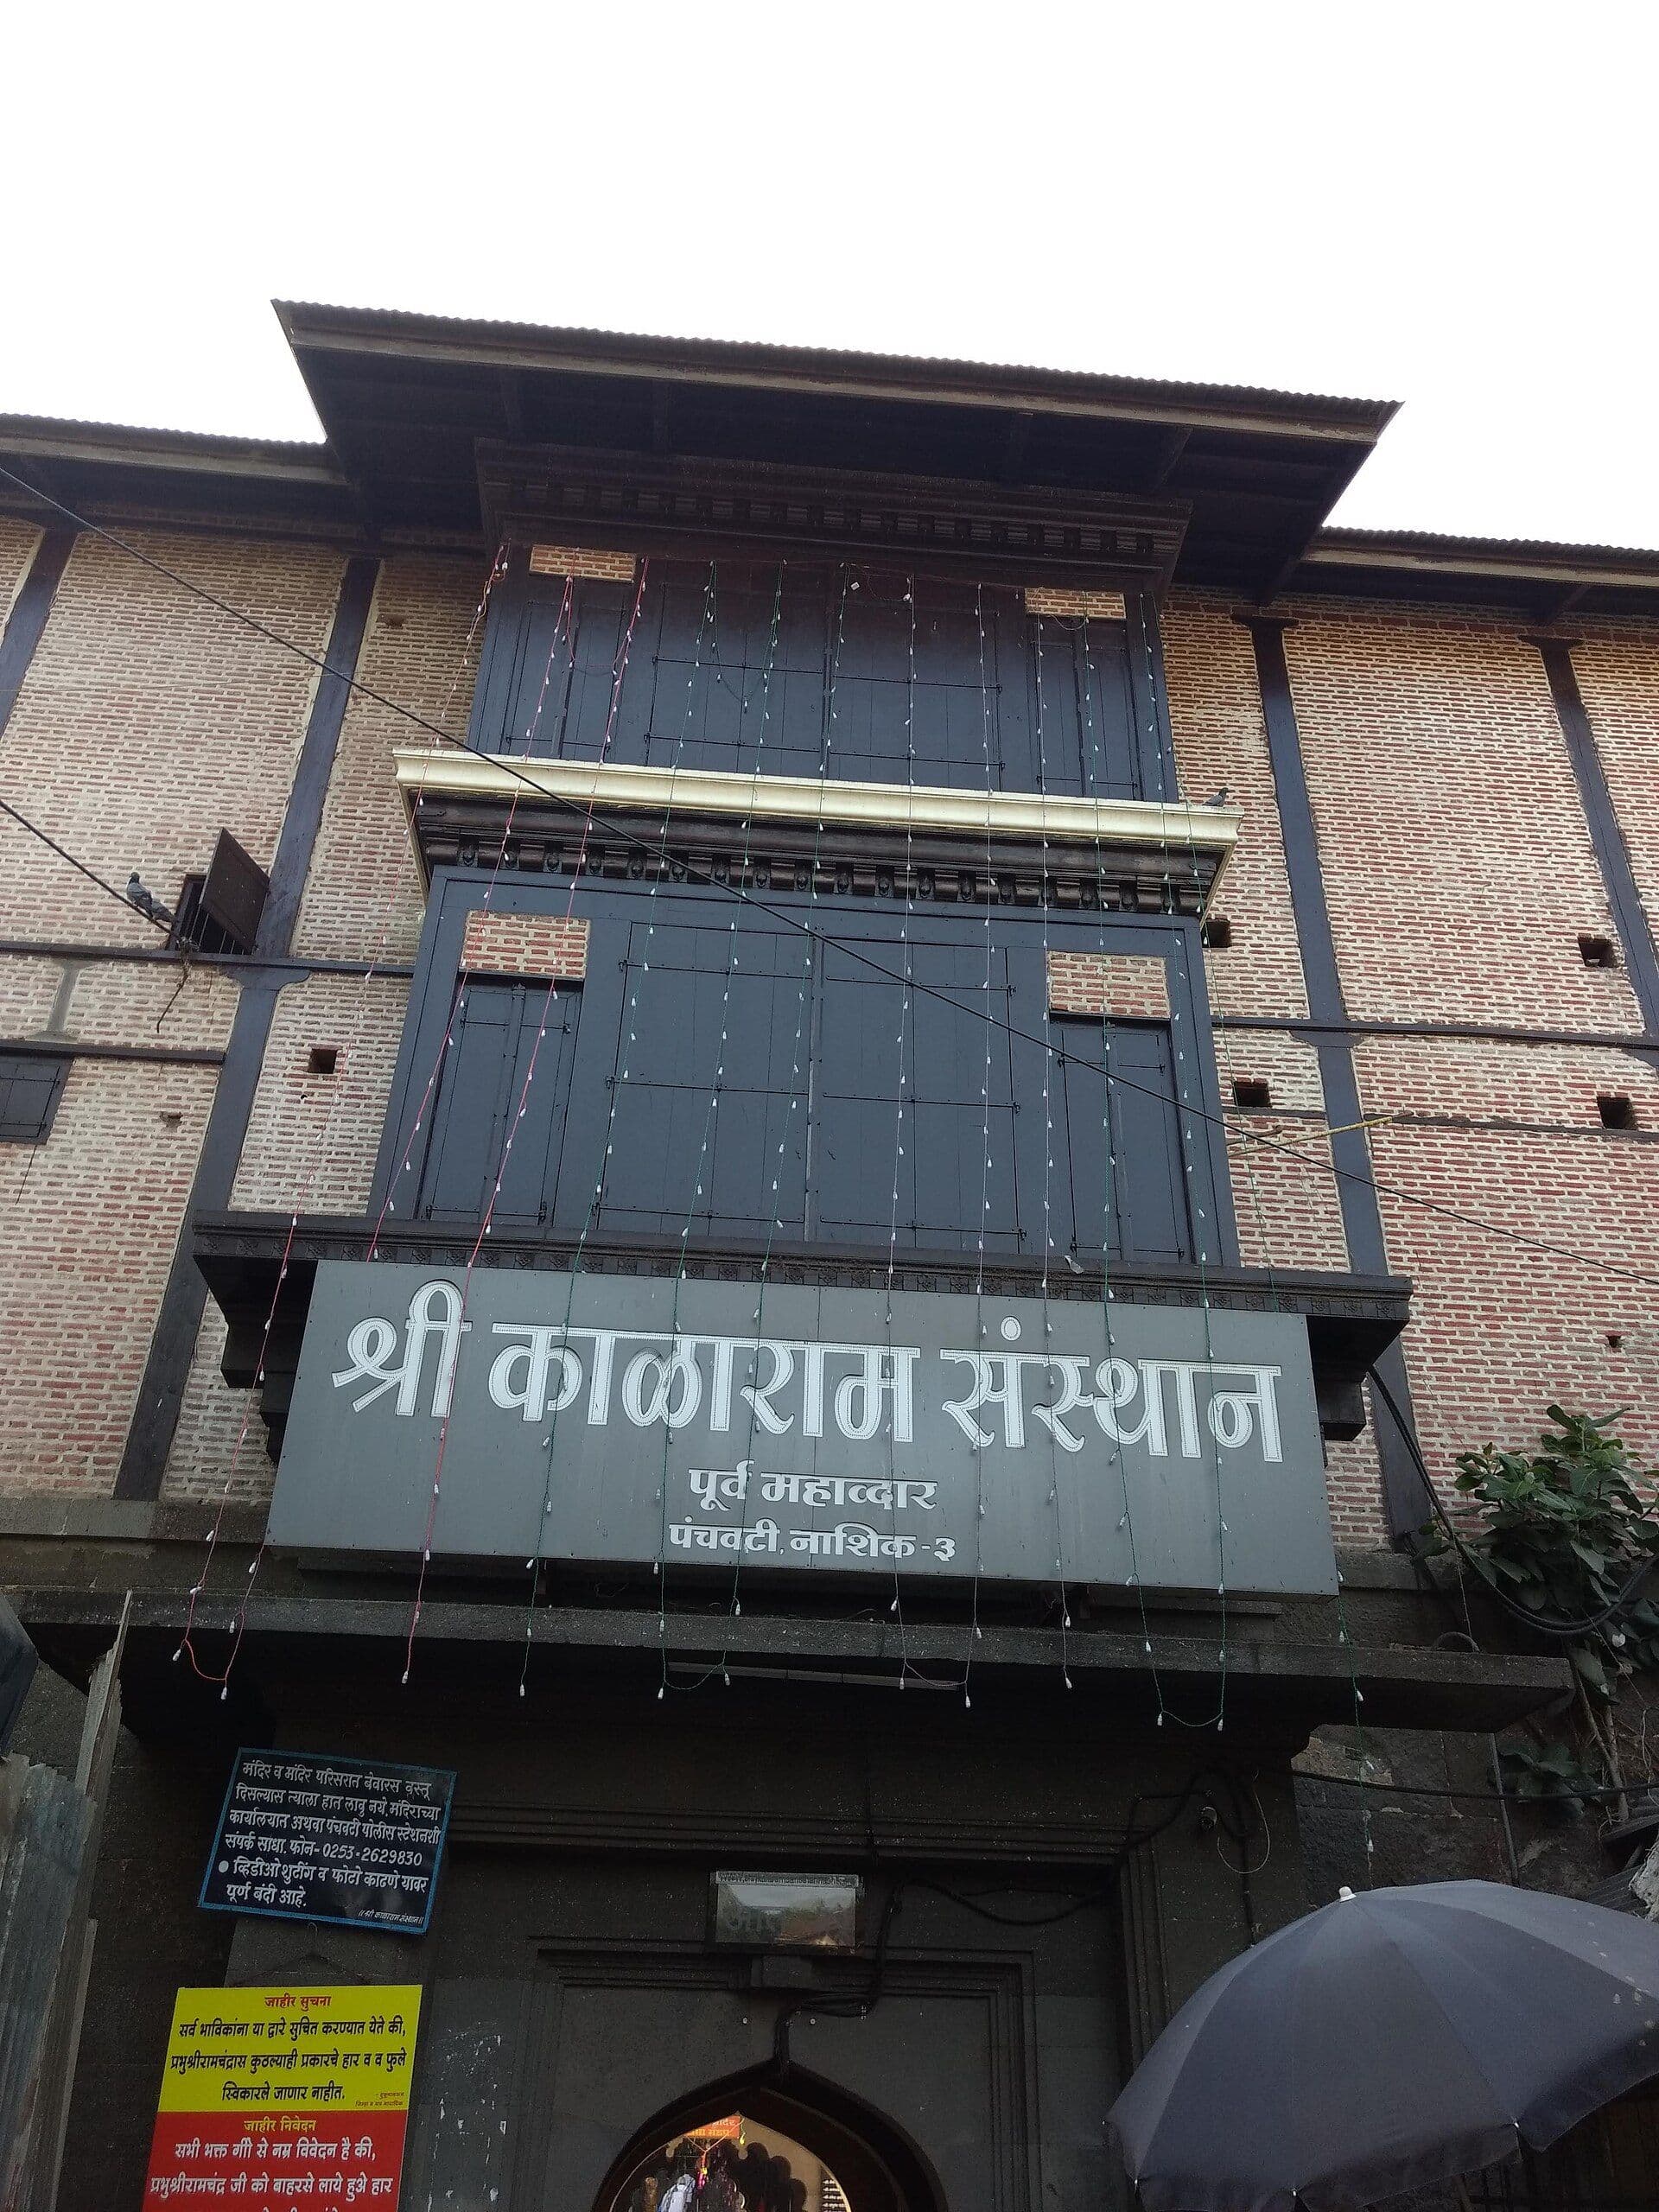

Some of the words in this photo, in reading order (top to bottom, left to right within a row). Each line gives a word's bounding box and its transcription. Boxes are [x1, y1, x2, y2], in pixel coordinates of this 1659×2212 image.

[331, 1279, 474, 1418] श्री
[488, 1320, 921, 1444] काळाराम
[939, 1315, 1282, 1463] संस्थान
[688, 1460, 755, 1511] पूर्व
[243, 1759, 272, 1780] मंदिर
[274, 1765, 285, 1780] व
[284, 1764, 313, 1783] मंदिर
[315, 1767, 363, 1789] परिसरात
[364, 1771, 402, 1793] बेवारस
[235, 1782, 286, 1804] दिसल्यास
[288, 1790, 321, 1808] त्याला
[321, 1795, 344, 1811] हात
[345, 1797, 367, 1818] लावु
[389, 1799, 442, 1821] मंदिराच्या
[229, 1807, 291, 1829] कार्यालयात
[291, 1815, 326, 1834] अथवा
[326, 1815, 362, 1838] पंचवटी
[361, 1818, 397, 1840] पोलीस
[397, 1821, 442, 1845] स्टेशनशी
[225, 1830, 256, 1851] संपर्क
[233, 1855, 282, 1878] व्हिडीओ
[281, 1860, 317, 1885] शुटींग
[317, 1866, 330, 1882] व
[331, 1864, 363, 1885] फोटो
[363, 1869, 401, 1890] काढणे
[401, 1875, 429, 1893] यावर
[226, 1881, 251, 1904] पूर्ण
[253, 1883, 278, 1904] बंदी
[278, 1885, 308, 1908] आहे.
[264, 1993, 296, 2008] जाहीर
[300, 1996, 332, 2012] सुचना
[179, 2018, 199, 2037] सर्व
[200, 2017, 250, 2037] भाविकांना
[252, 2023, 264, 2037] या
[267, 2016, 286, 2038] द्वारे
[289, 2015, 319, 2042] सुचित
[321, 2021, 365, 2035] करण्यात
[369, 2015, 385, 2035] येते
[388, 2014, 406, 2037] की,
[170, 2049, 248, 2075] प्रभुश्रीरामचंद्रास
[250, 2048, 298, 2074] कुठल्याही
[301, 2047, 340, 2068] प्रकारचे
[342, 2053, 360, 2069] हार
[363, 2053, 372, 2066] व
[374, 2053, 384, 2066] व
[385, 2046, 407, 2072] फुले
[221, 2081, 270, 2101] स्विकारले
[273, 2086, 308, 2101] जाणार
[310, 2080, 346, 2101] नाहीत.
[244, 2115, 277, 2133] जाहीर
[280, 2114, 317, 2133] निवेदन
[175, 2137, 201, 2158] सभी
[204, 2142, 230, 2158] भक्त
[256, 2137, 270, 2158] से
[272, 2143, 292, 2159] नम्र
[296, 2136, 338, 2160] विवेदन
[340, 2136, 351, 2160] है
[354, 2135, 376, 2161] की,
[150, 2171, 227, 2199] प्रभुश्रीरामचंद्र
[230, 2171, 248, 2193] जी
[251, 2171, 270, 2193] को
[273, 2171, 315, 2196] बाहरसे
[318, 2171, 344, 2193] लाये
[371, 2177, 394, 2196] हार
